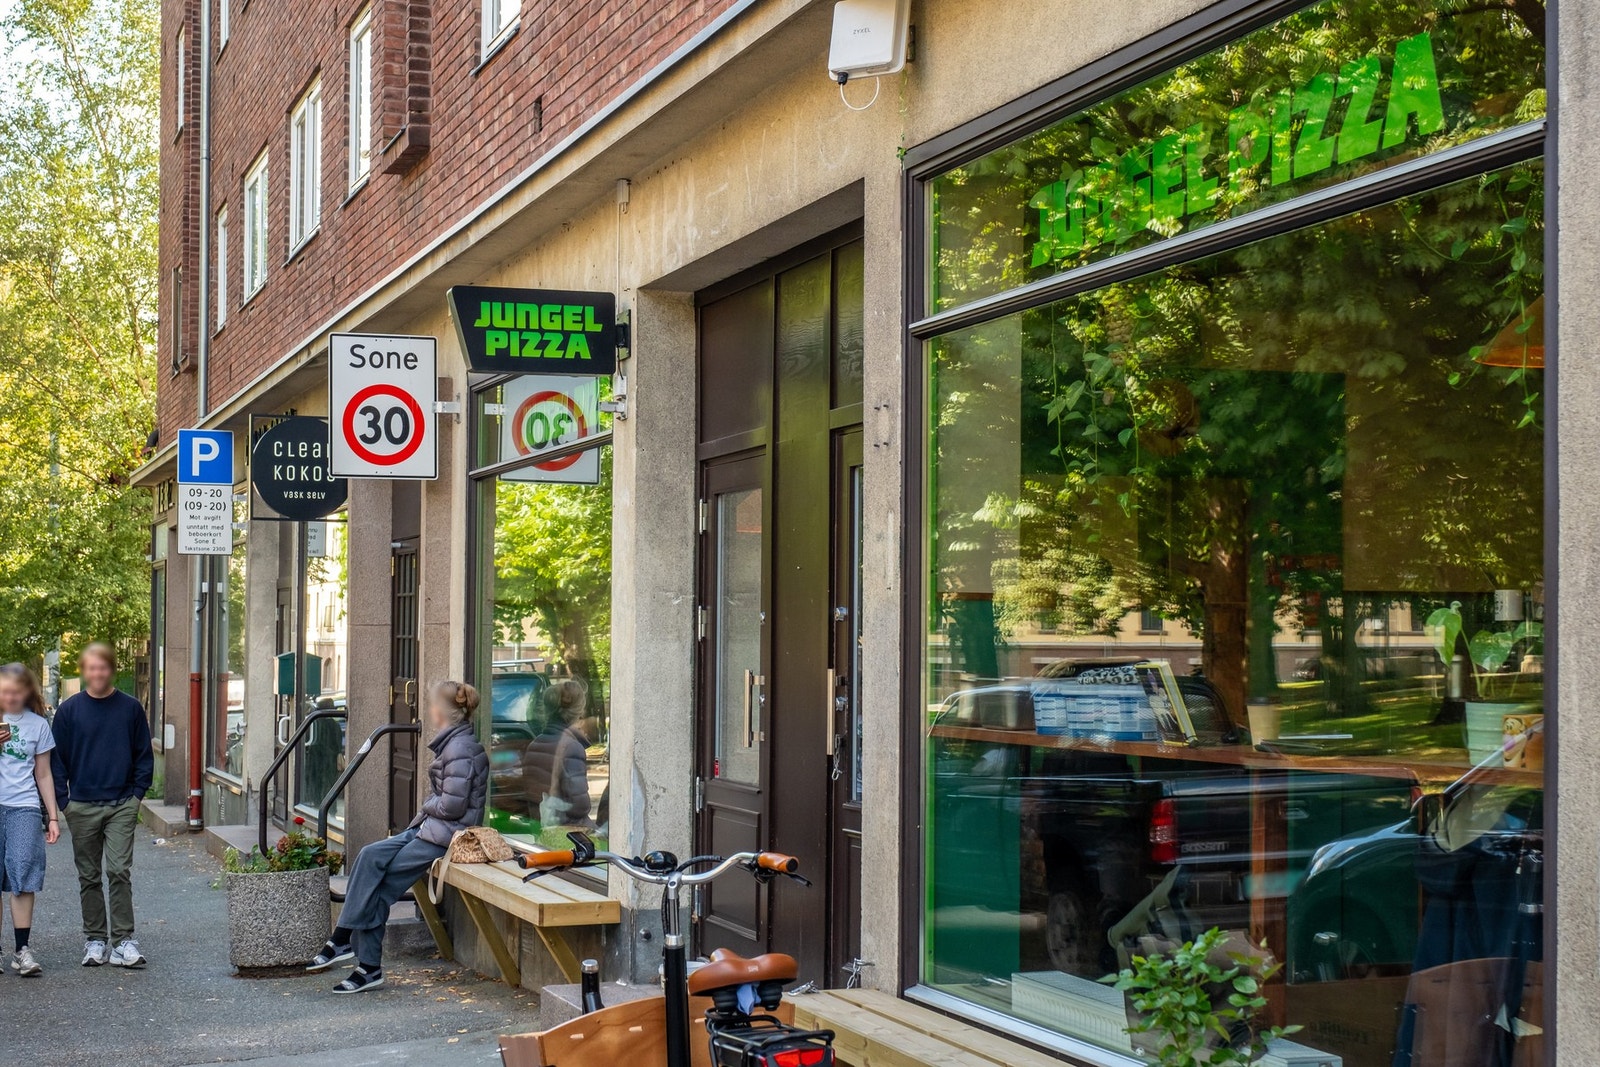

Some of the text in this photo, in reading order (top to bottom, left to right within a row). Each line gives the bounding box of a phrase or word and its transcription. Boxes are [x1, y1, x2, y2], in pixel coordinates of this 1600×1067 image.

[853, 27, 871, 35] ZYXEL
[1228, 31, 1445, 192] PIZZA
[473, 301, 603, 333] JUNGEL
[349, 343, 418, 370] Sone
[485, 330, 592, 360] PIZZA
[359, 405, 410, 446] 30
[192, 437, 220, 476] P
